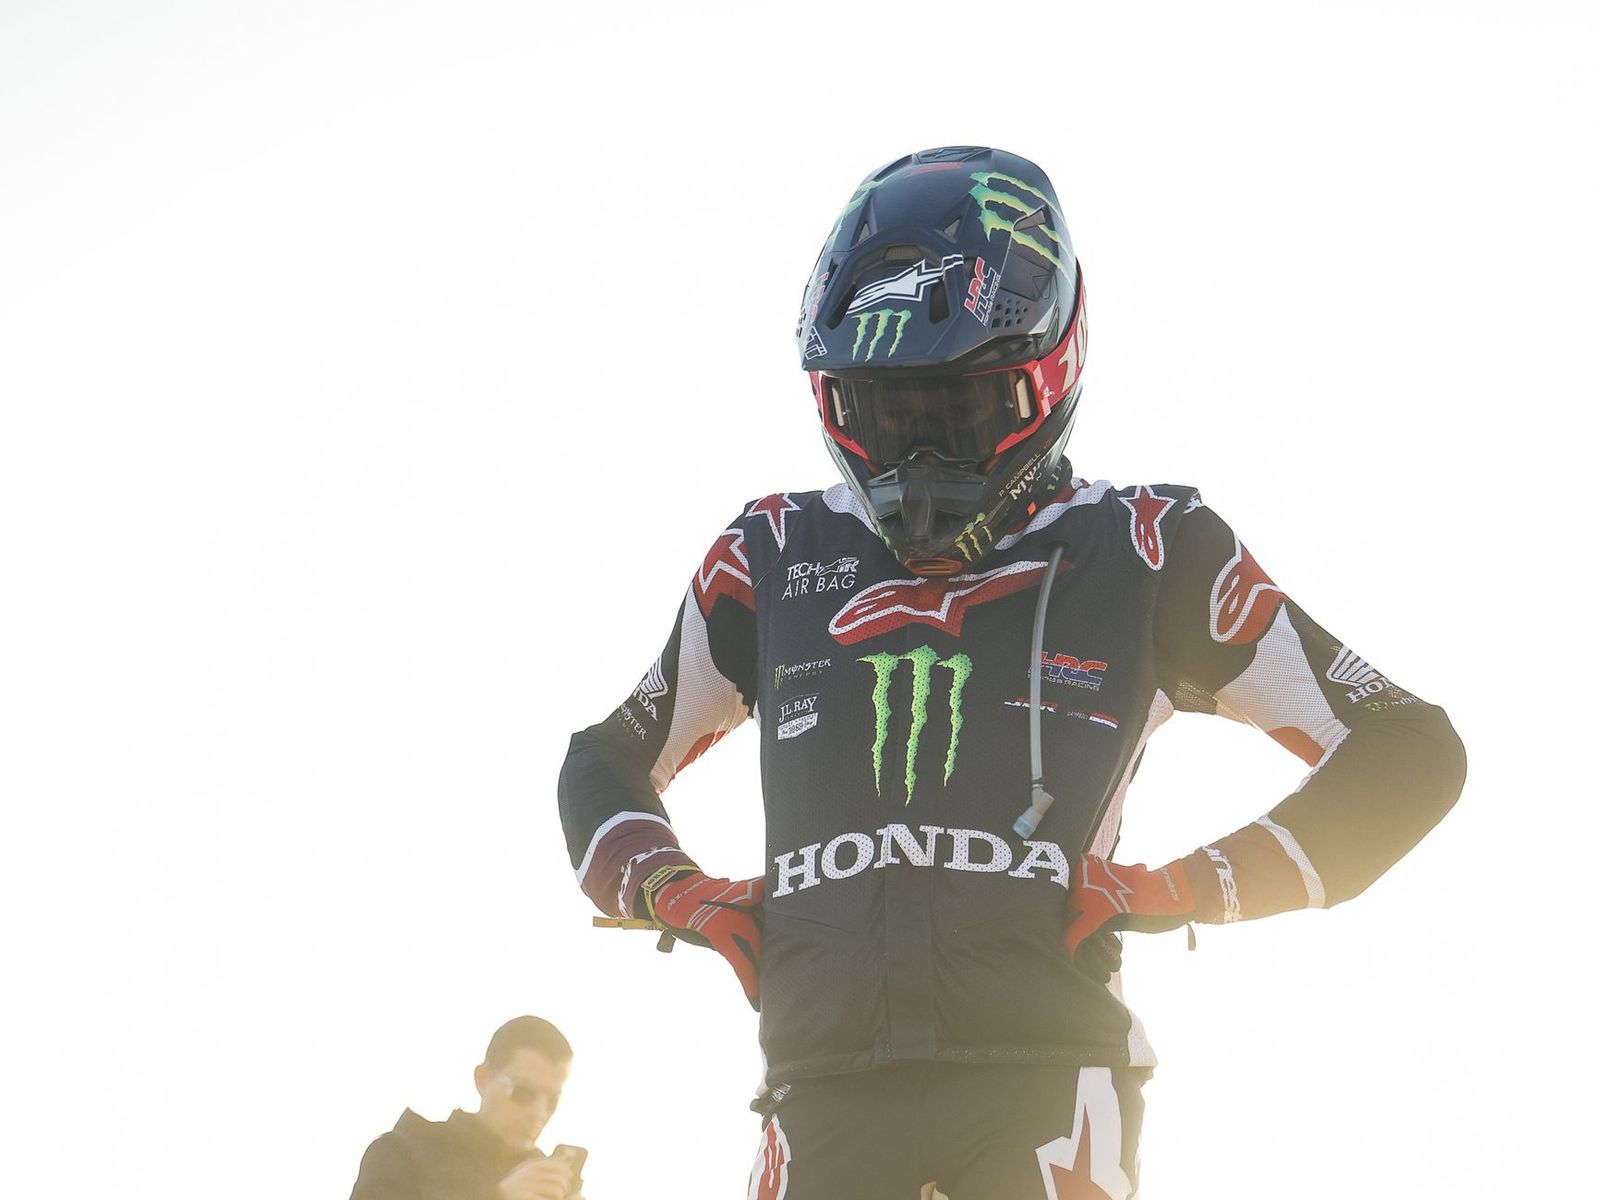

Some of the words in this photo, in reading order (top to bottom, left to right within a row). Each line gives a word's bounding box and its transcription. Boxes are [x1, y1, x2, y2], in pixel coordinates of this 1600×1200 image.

[787, 562, 821, 582] TECH
[781, 577, 809, 601] AIR
[815, 573, 856, 593] BAG
[793, 696, 817, 713] RAY
[772, 823, 1070, 898] HONDA
